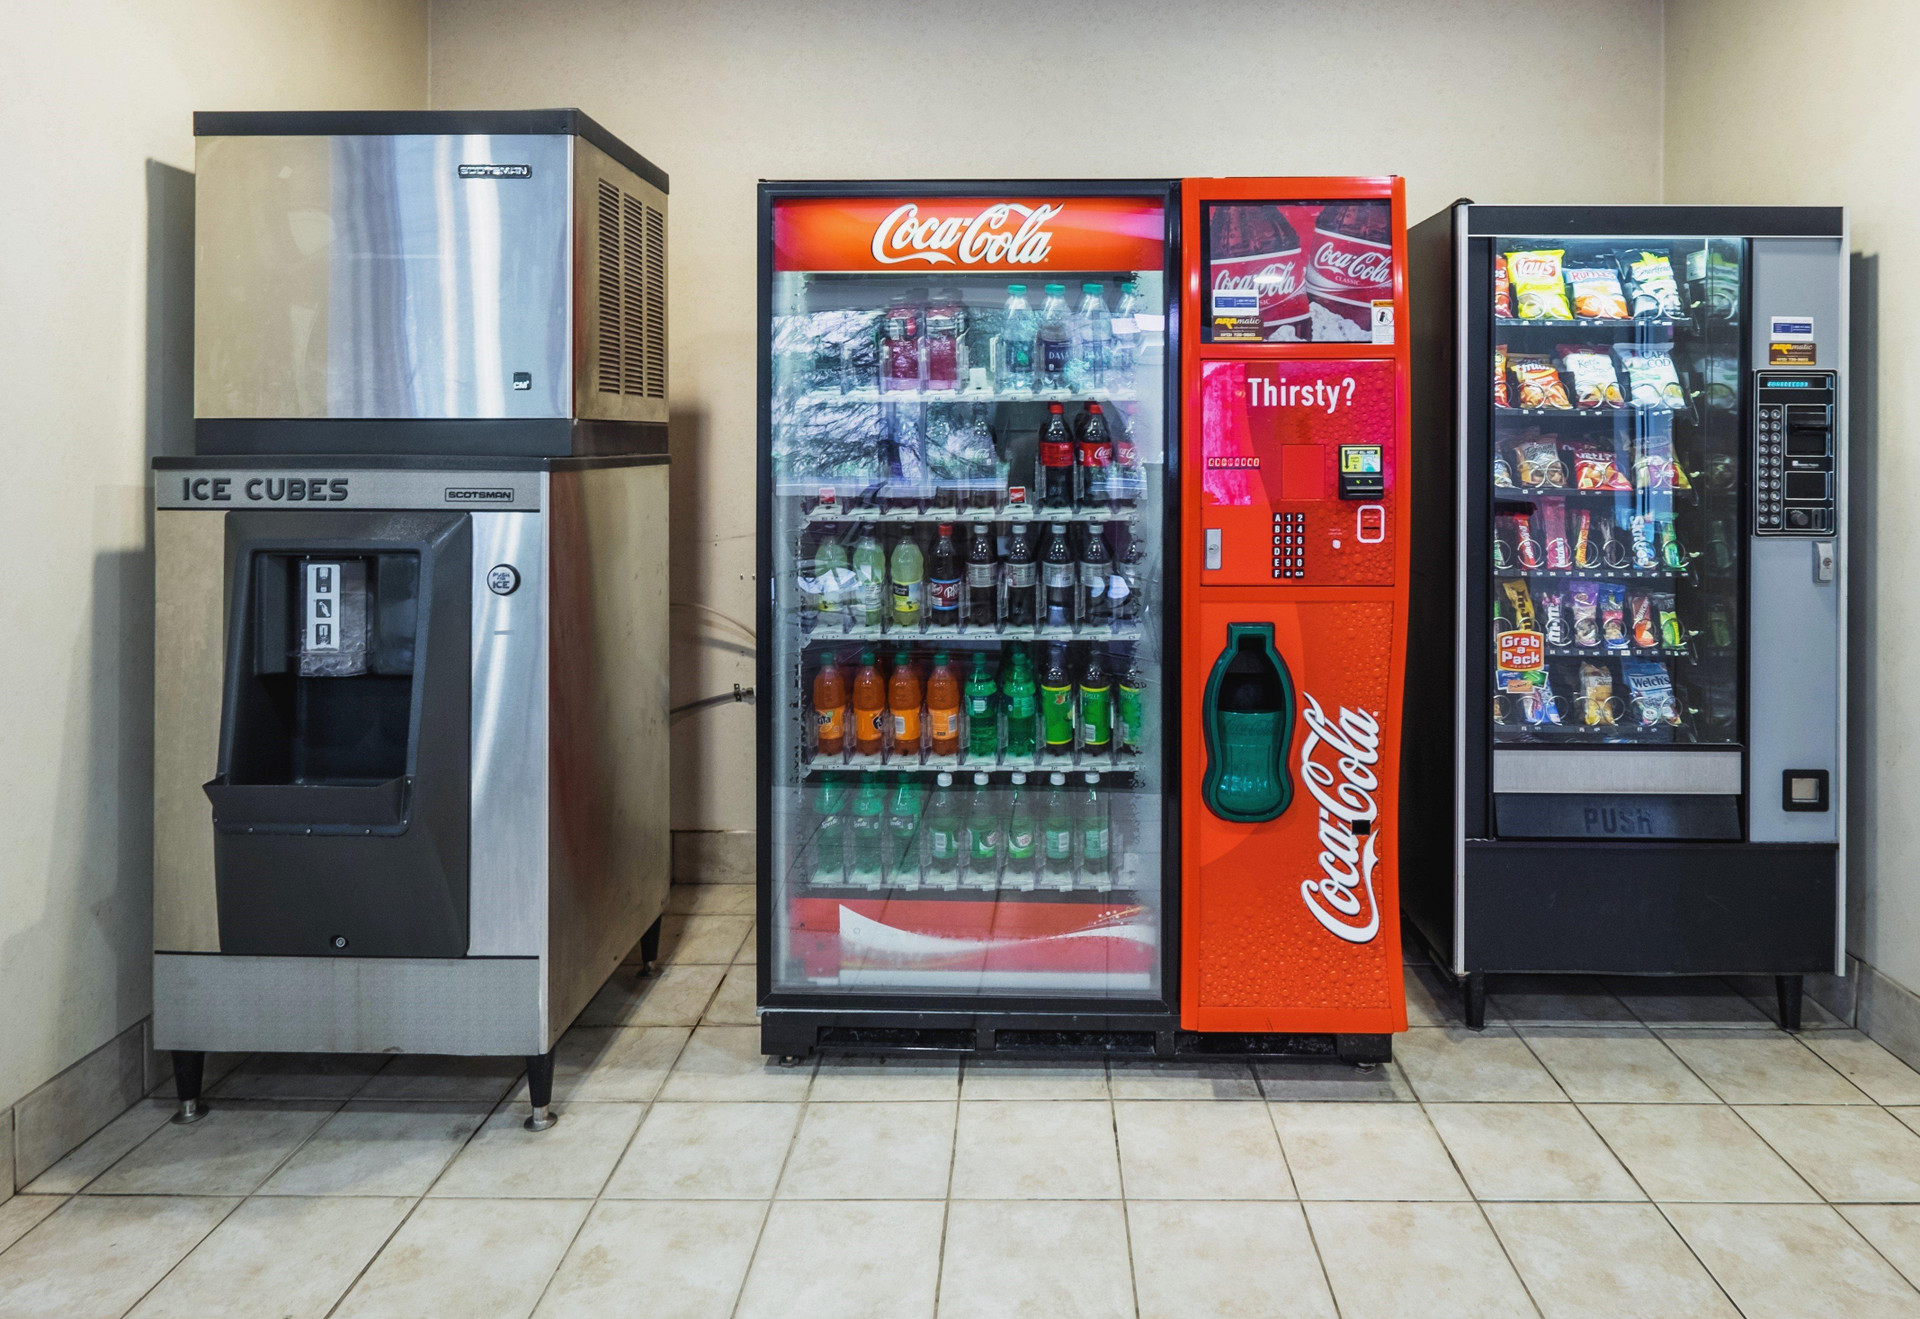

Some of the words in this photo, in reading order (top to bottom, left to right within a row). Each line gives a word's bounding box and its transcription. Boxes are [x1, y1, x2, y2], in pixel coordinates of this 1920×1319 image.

[870, 202, 1065, 265] Coca-Cola
[1314, 241, 1392, 283] Coca-Cola
[1335, 275, 1361, 286] CLASSIC
[1647, 359, 1671, 368] COD
[1247, 377, 1356, 414] Thirsty?
[183, 477, 232, 501] ICE
[245, 477, 349, 501] CUBES
[448, 491, 511, 499] SCOTSMAN
[1275, 514, 1281, 522] A
[1286, 514, 1291, 522] 1
[1297, 514, 1303, 522] 2
[1274, 525, 1280, 533] B
[1286, 525, 1291, 533] 3
[1297, 525, 1303, 533] 4
[1274, 536, 1280, 545] C
[1286, 536, 1291, 545] 5
[1297, 536, 1303, 545] 6
[1274, 547, 1280, 556] D
[1286, 547, 1291, 556] 7
[1297, 547, 1303, 556] 8
[1274, 558, 1280, 567] E
[1286, 558, 1291, 567] 9
[1297, 558, 1303, 567] 0
[1274, 570, 1280, 578] F
[493, 581, 510, 589] ICE
[1501, 635, 1540, 648] Grab
[1517, 646, 1526, 654] a
[1501, 650, 1540, 665] Pack
[1631, 675, 1672, 688] Welch's
[1301, 690, 1380, 942] Coca-Cola
[1583, 806, 1653, 835] PUSH
